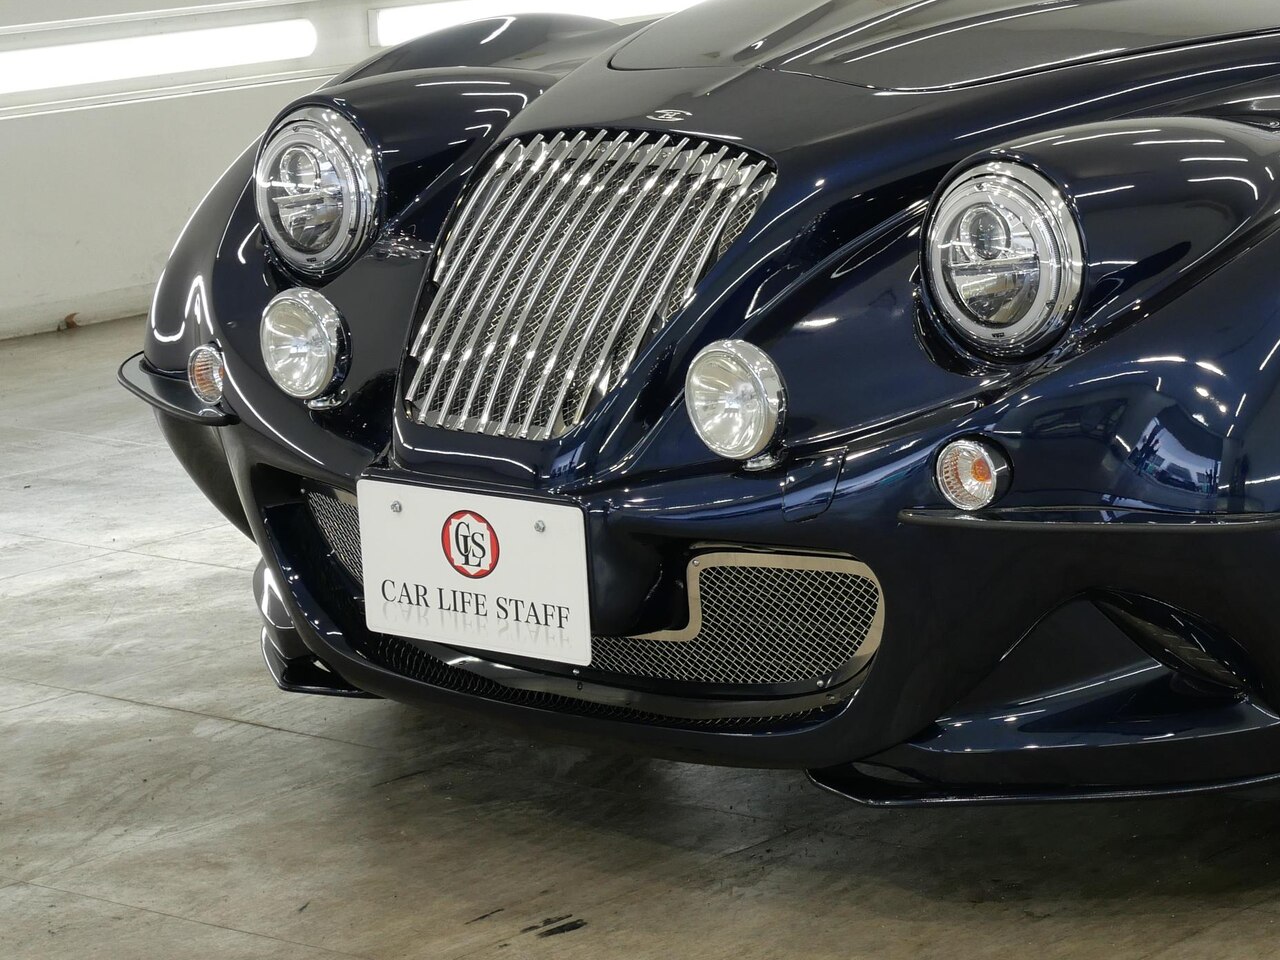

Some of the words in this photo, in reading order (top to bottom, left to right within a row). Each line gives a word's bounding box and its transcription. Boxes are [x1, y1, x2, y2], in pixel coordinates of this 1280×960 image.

[381, 579, 430, 607] CAR
[436, 587, 488, 617] LIFE
[496, 596, 570, 629] STAFF
